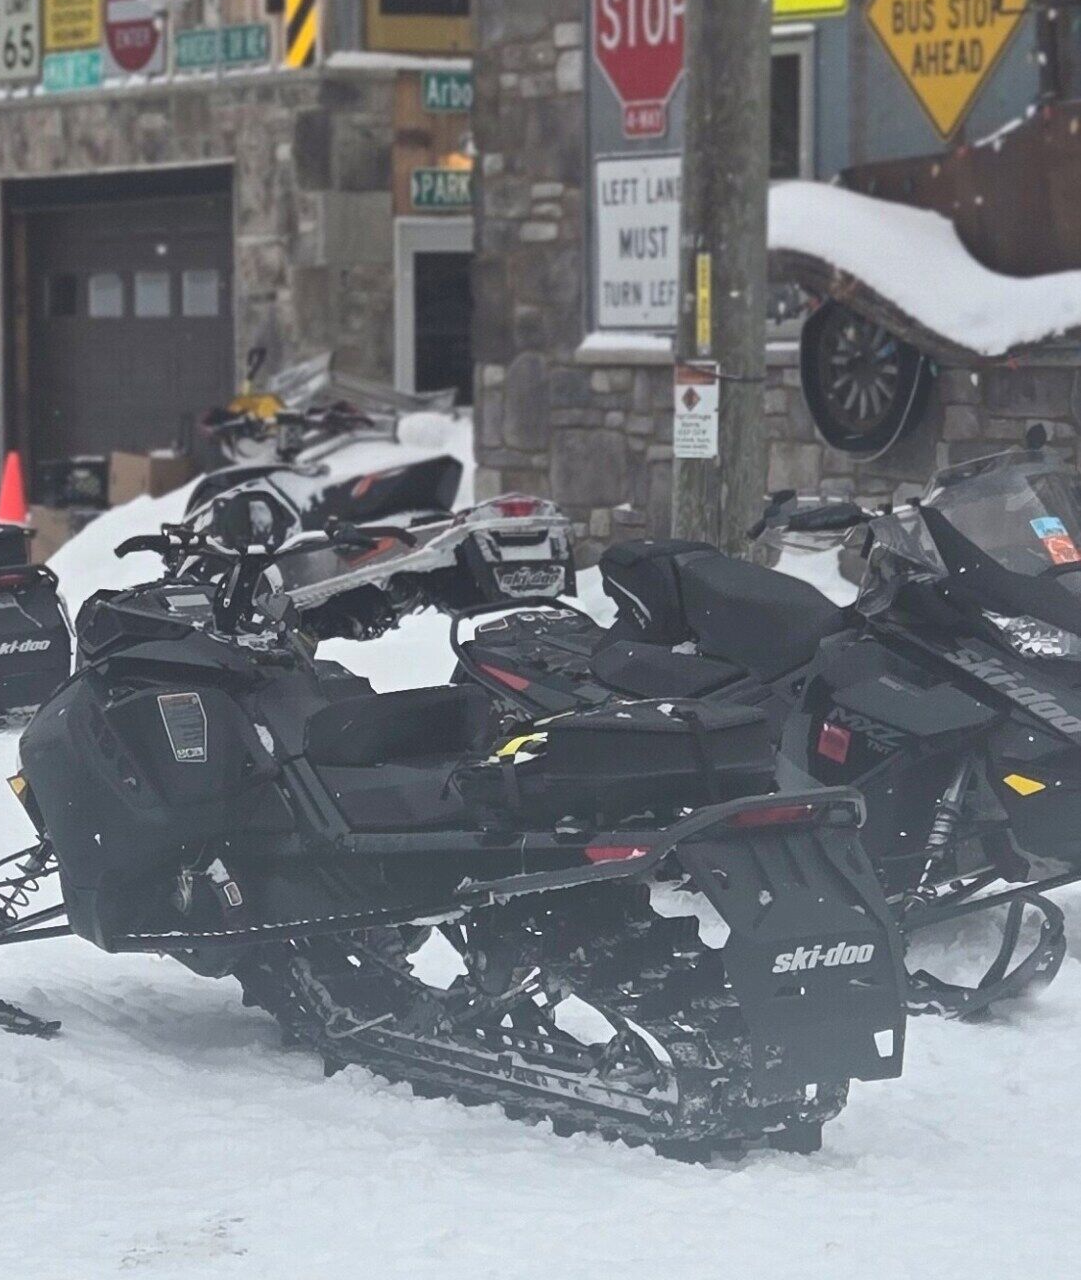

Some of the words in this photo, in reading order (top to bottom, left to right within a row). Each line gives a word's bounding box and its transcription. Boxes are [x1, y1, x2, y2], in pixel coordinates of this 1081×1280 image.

[3, 22, 34, 70] 65
[910, 38, 984, 77] AHEAD
[427, 76, 474, 108] Arbo
[602, 177, 638, 206] LEFT
[619, 225, 669, 260] MUST
[603, 280, 643, 308] TURN
[649, 280, 677, 307] LEF
[772, 942, 875, 974] ski-doo
